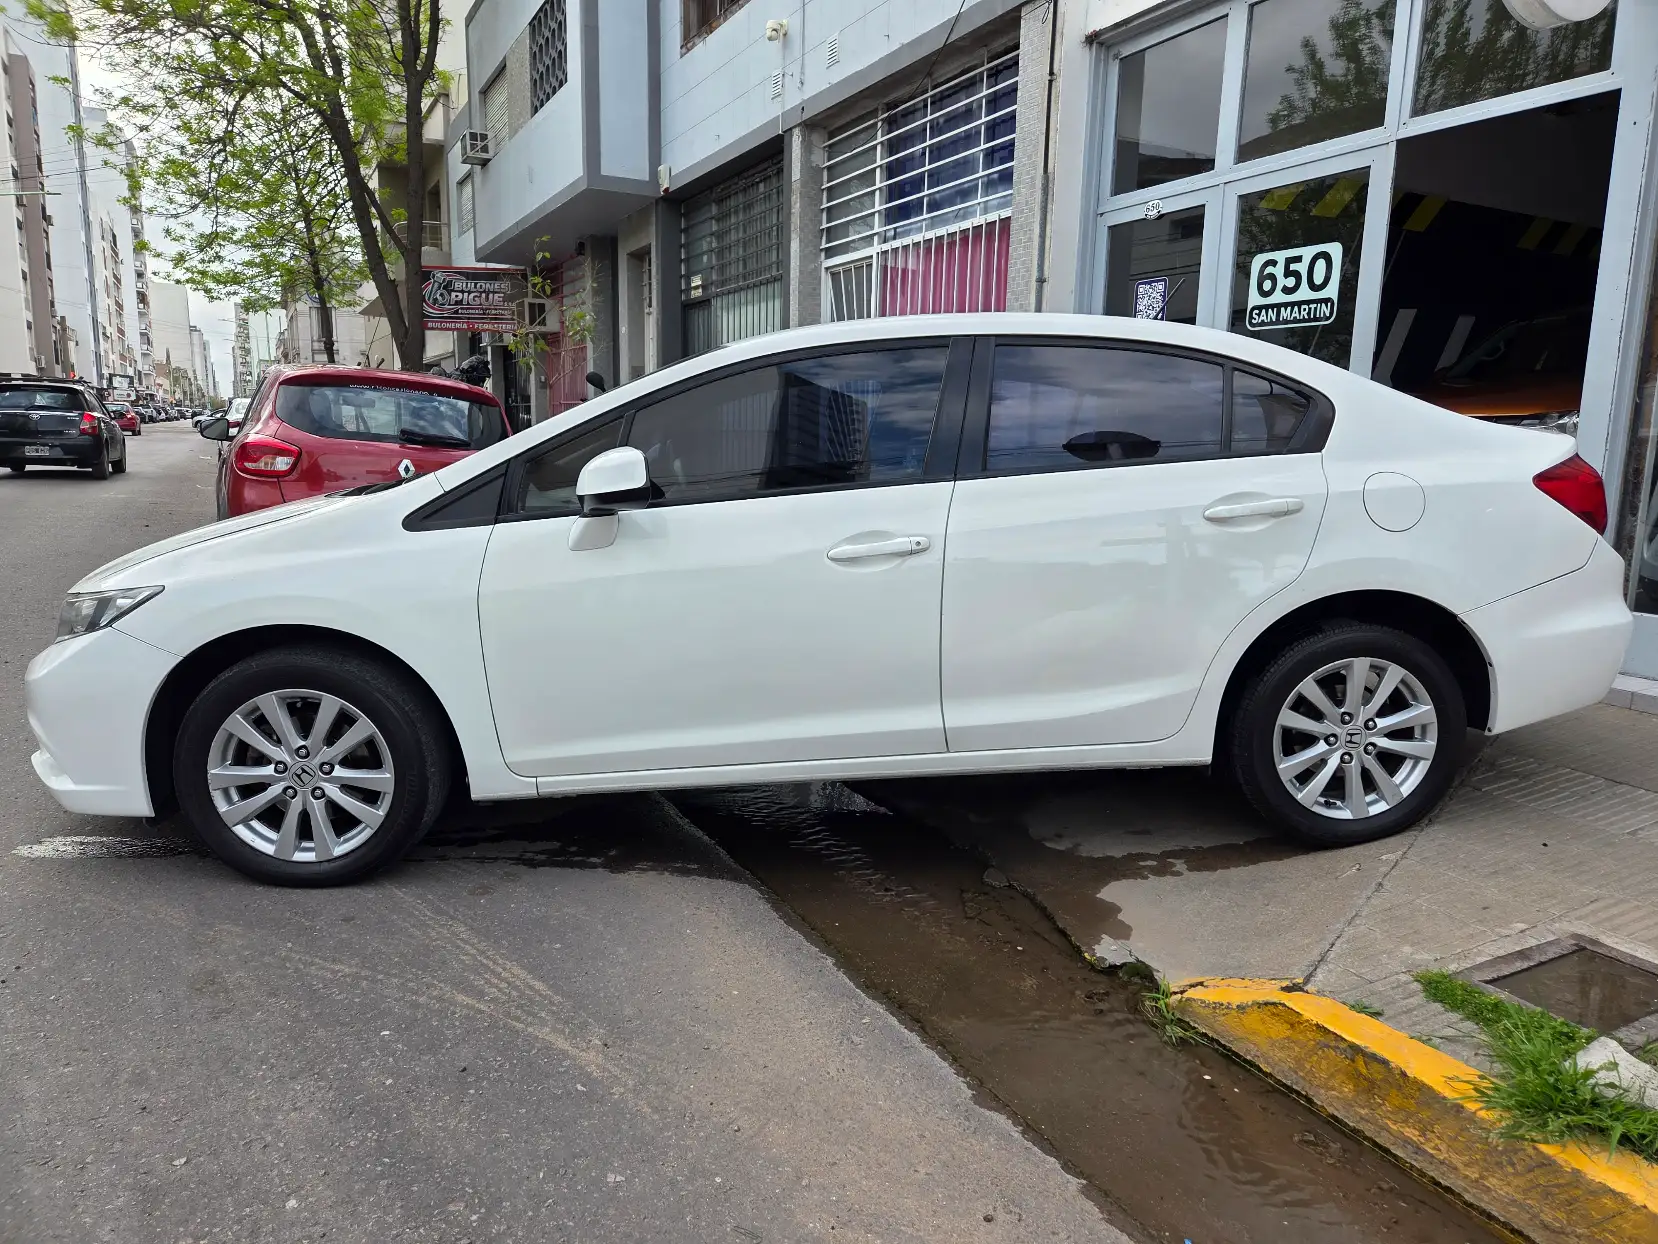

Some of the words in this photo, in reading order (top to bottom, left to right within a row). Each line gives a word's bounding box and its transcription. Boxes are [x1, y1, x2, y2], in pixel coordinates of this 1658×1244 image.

[1145, 201, 1160, 213] 650
[1257, 250, 1333, 298] 650
[453, 282, 508, 292] BULONES
[450, 292, 504, 306] PIGUE
[1251, 307, 1277, 324] SAN
[1279, 302, 1331, 321] MARTIN
